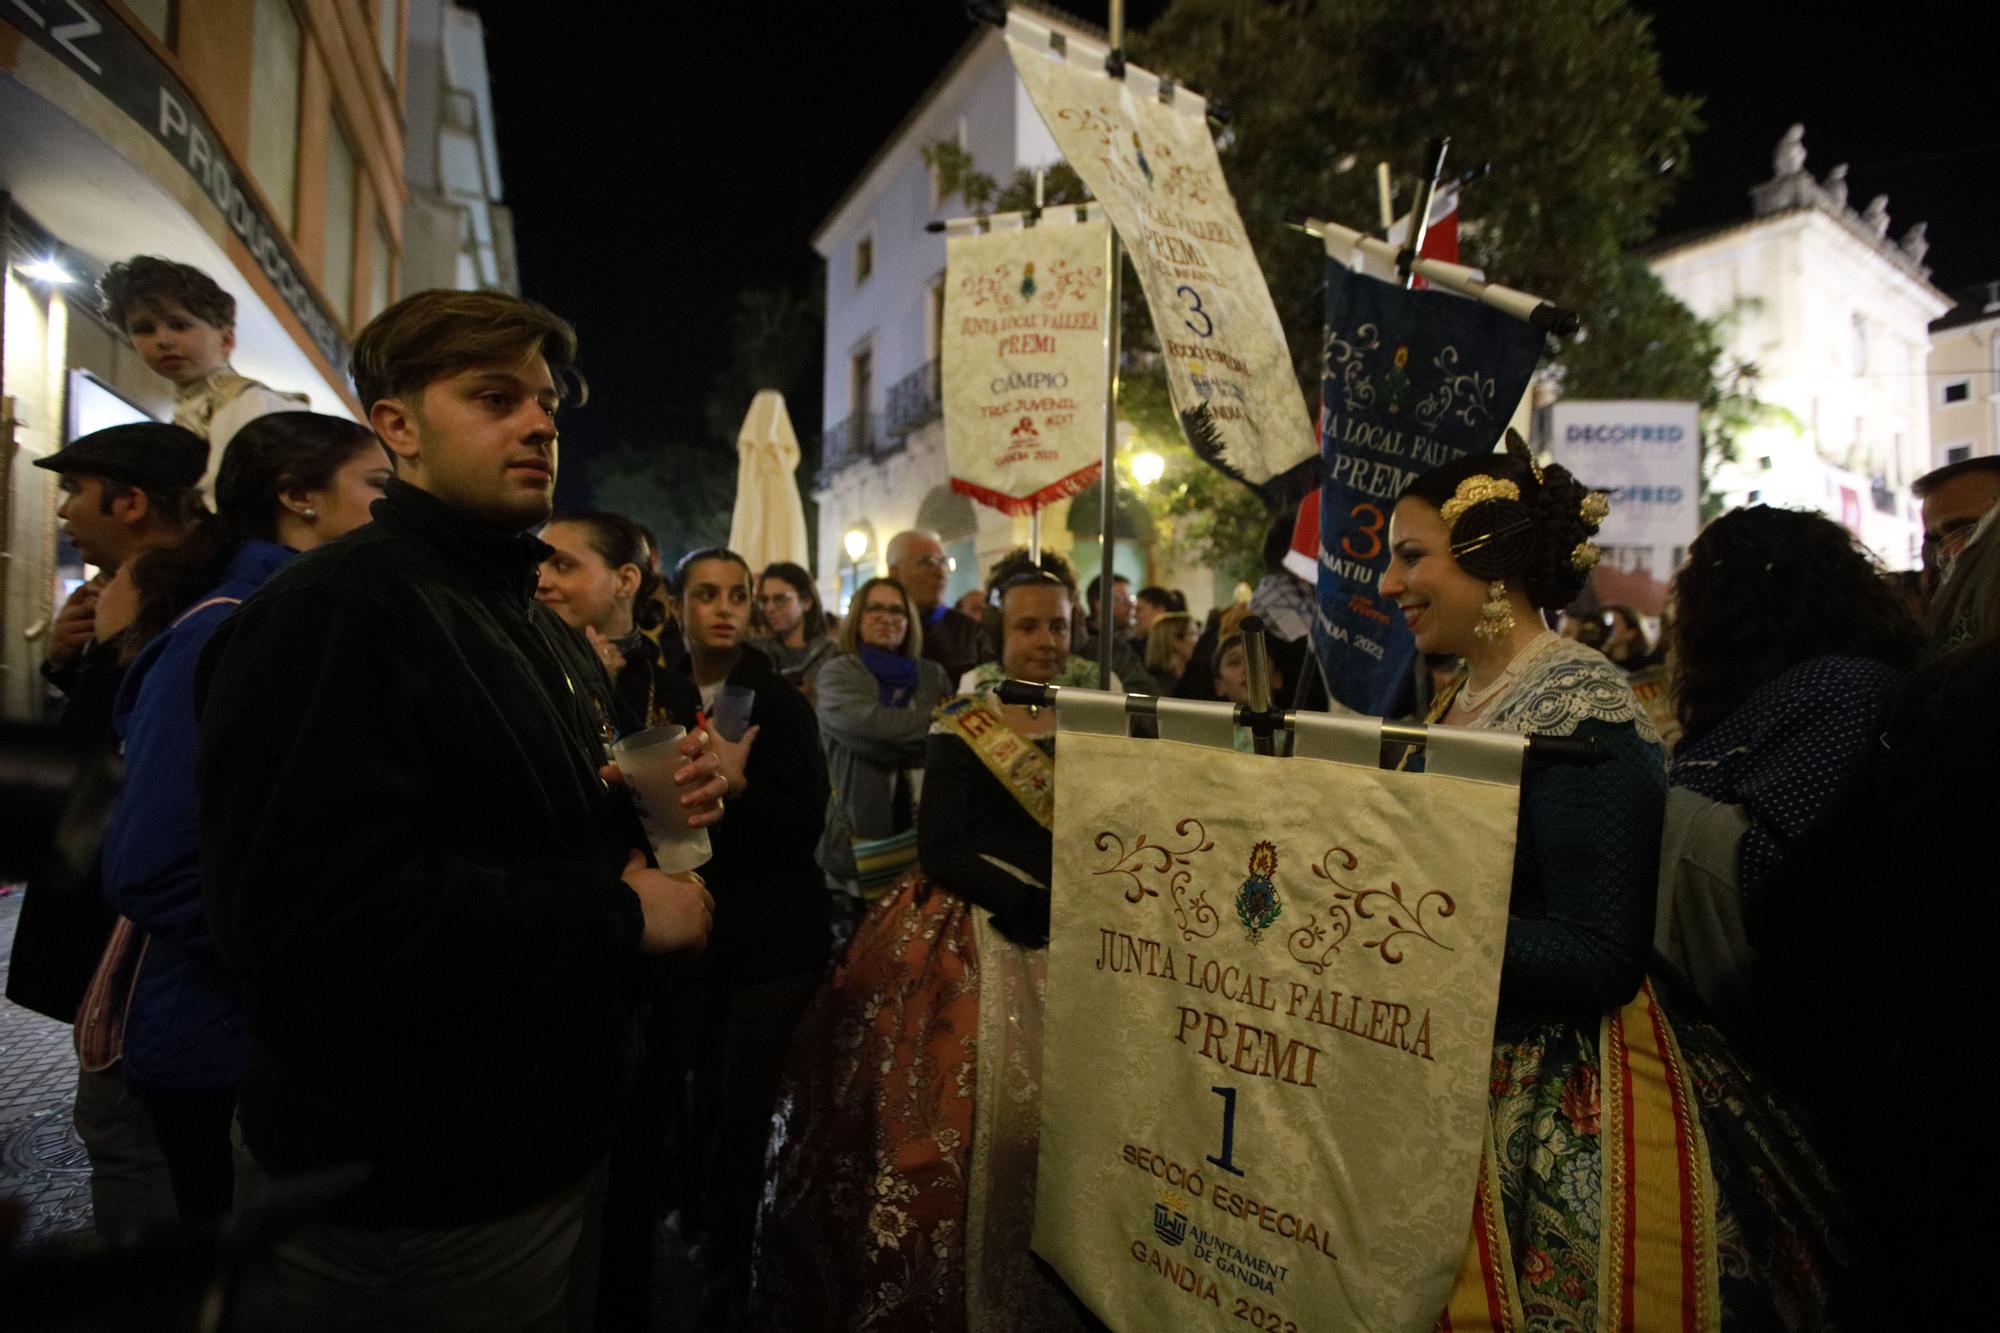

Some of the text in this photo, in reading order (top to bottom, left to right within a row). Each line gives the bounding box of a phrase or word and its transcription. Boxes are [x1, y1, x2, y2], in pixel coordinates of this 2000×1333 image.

[1177, 285, 1213, 338] 3
[998, 332, 1057, 357] PREMI
[1343, 418, 1404, 455] LOCAL
[1331, 453, 1420, 500] PREM
[1342, 503, 1385, 560] 3
[1097, 928, 1435, 1061] JUNTA LOCAL FALLERA
[1174, 1005, 1322, 1088] PREMI
[1206, 1085, 1245, 1178] 1
[1122, 1143, 1338, 1261] SECCIÓ ESPECIAL
[1130, 1239, 1221, 1308] GANDIA
[1188, 1225, 1289, 1283] AJUNTAMENT
[1192, 1244, 1275, 1296] DE GANDIA
